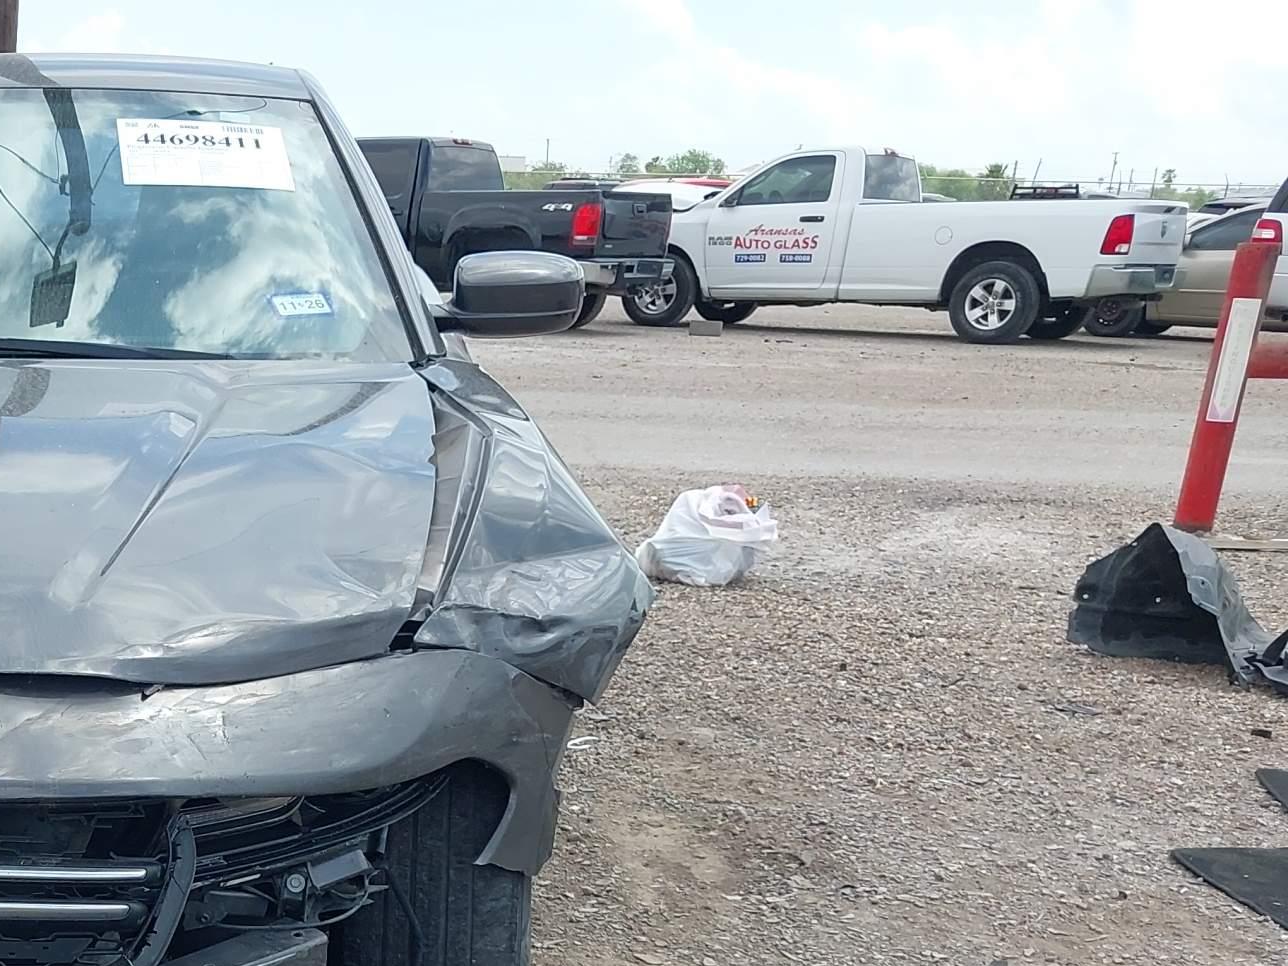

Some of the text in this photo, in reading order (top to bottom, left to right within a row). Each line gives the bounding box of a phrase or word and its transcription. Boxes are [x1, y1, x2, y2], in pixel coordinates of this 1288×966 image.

[135, 132, 262, 150] 44698411
[745, 223, 805, 236] Aransas
[734, 234, 819, 250] AUTO GLASS
